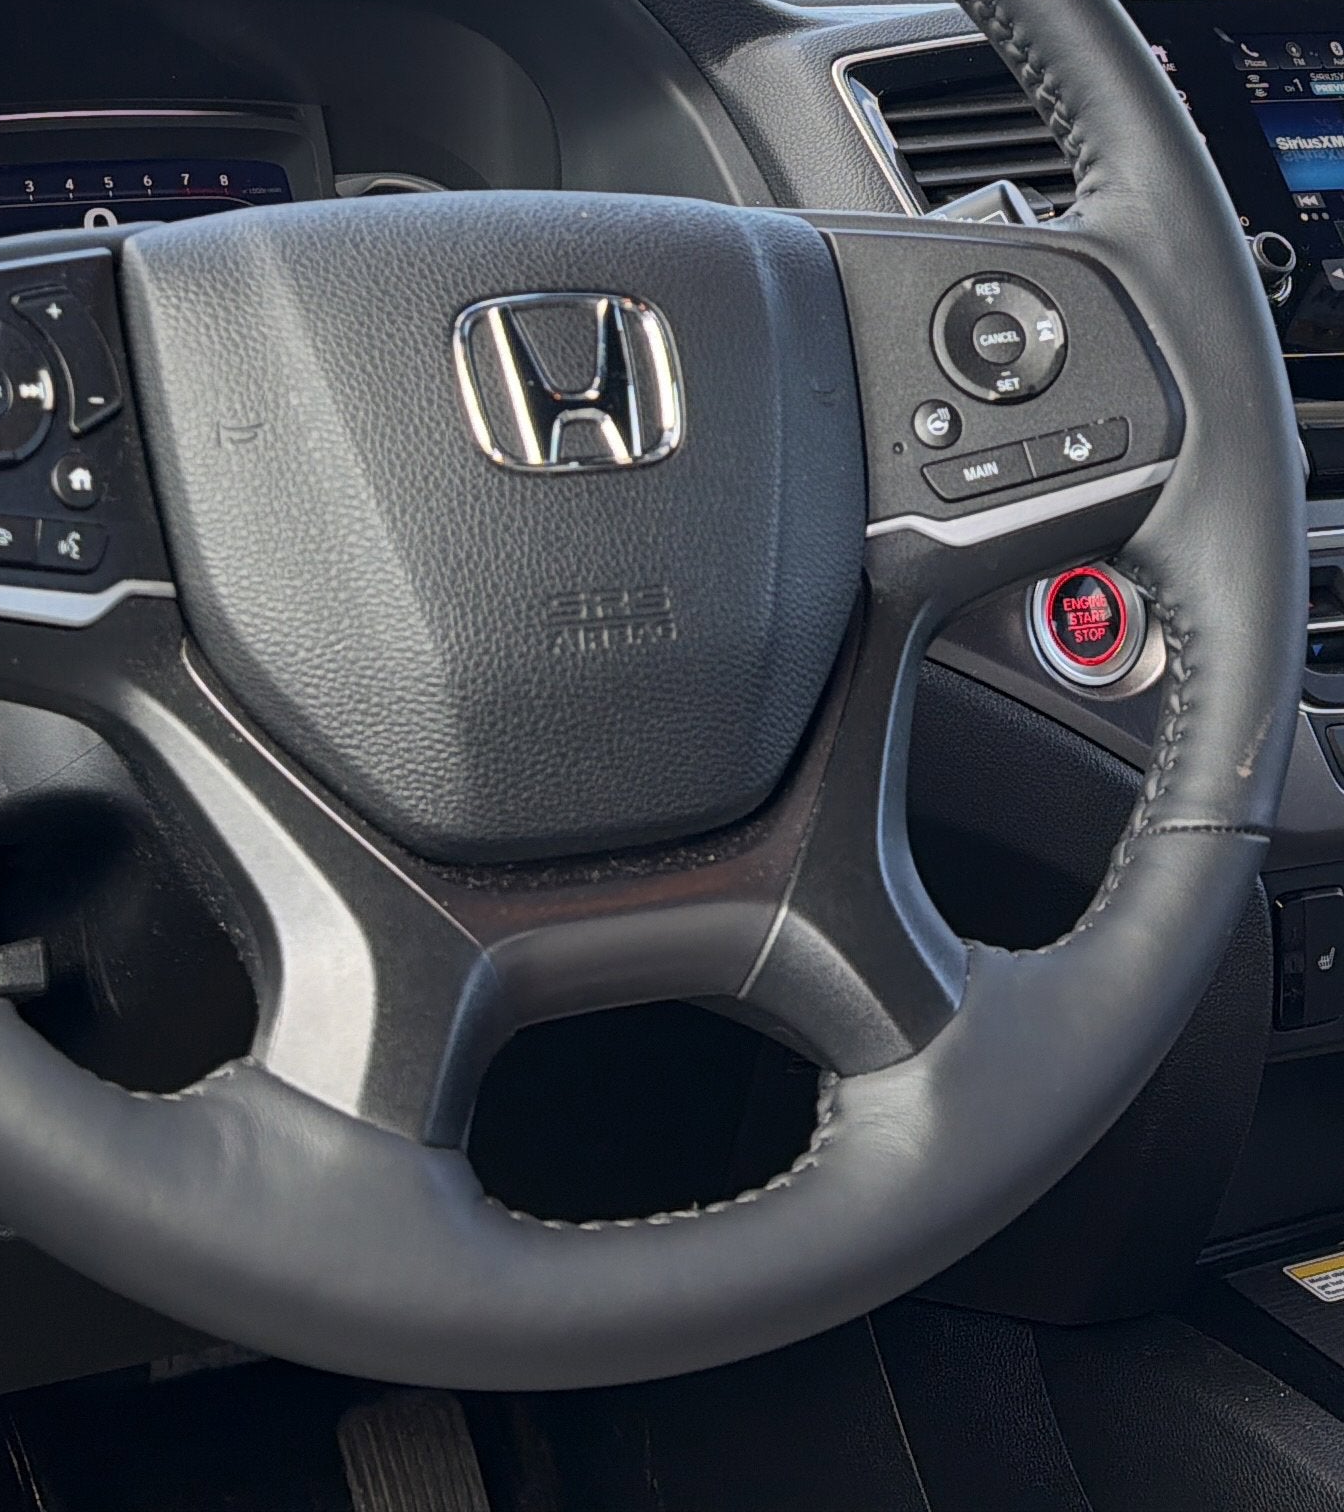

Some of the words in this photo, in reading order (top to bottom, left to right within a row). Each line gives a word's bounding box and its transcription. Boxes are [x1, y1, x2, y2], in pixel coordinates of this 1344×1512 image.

[1293, 78, 1303, 92] 1
[25, 180, 35, 193] 3
[65, 178, 74, 190] 4
[104, 176, 113, 188] 5
[143, 174, 152, 186] 6
[181, 173, 190, 185] 7
[219, 174, 229, 186] 8
[975, 281, 1001, 296] RES
[979, 331, 1021, 346] CANCEL
[996, 377, 1020, 393] SET
[963, 461, 999, 481] MAIN
[1062, 595, 1107, 612] ENGINE
[1068, 609, 1107, 626] START
[1074, 627, 1106, 643] STOP
